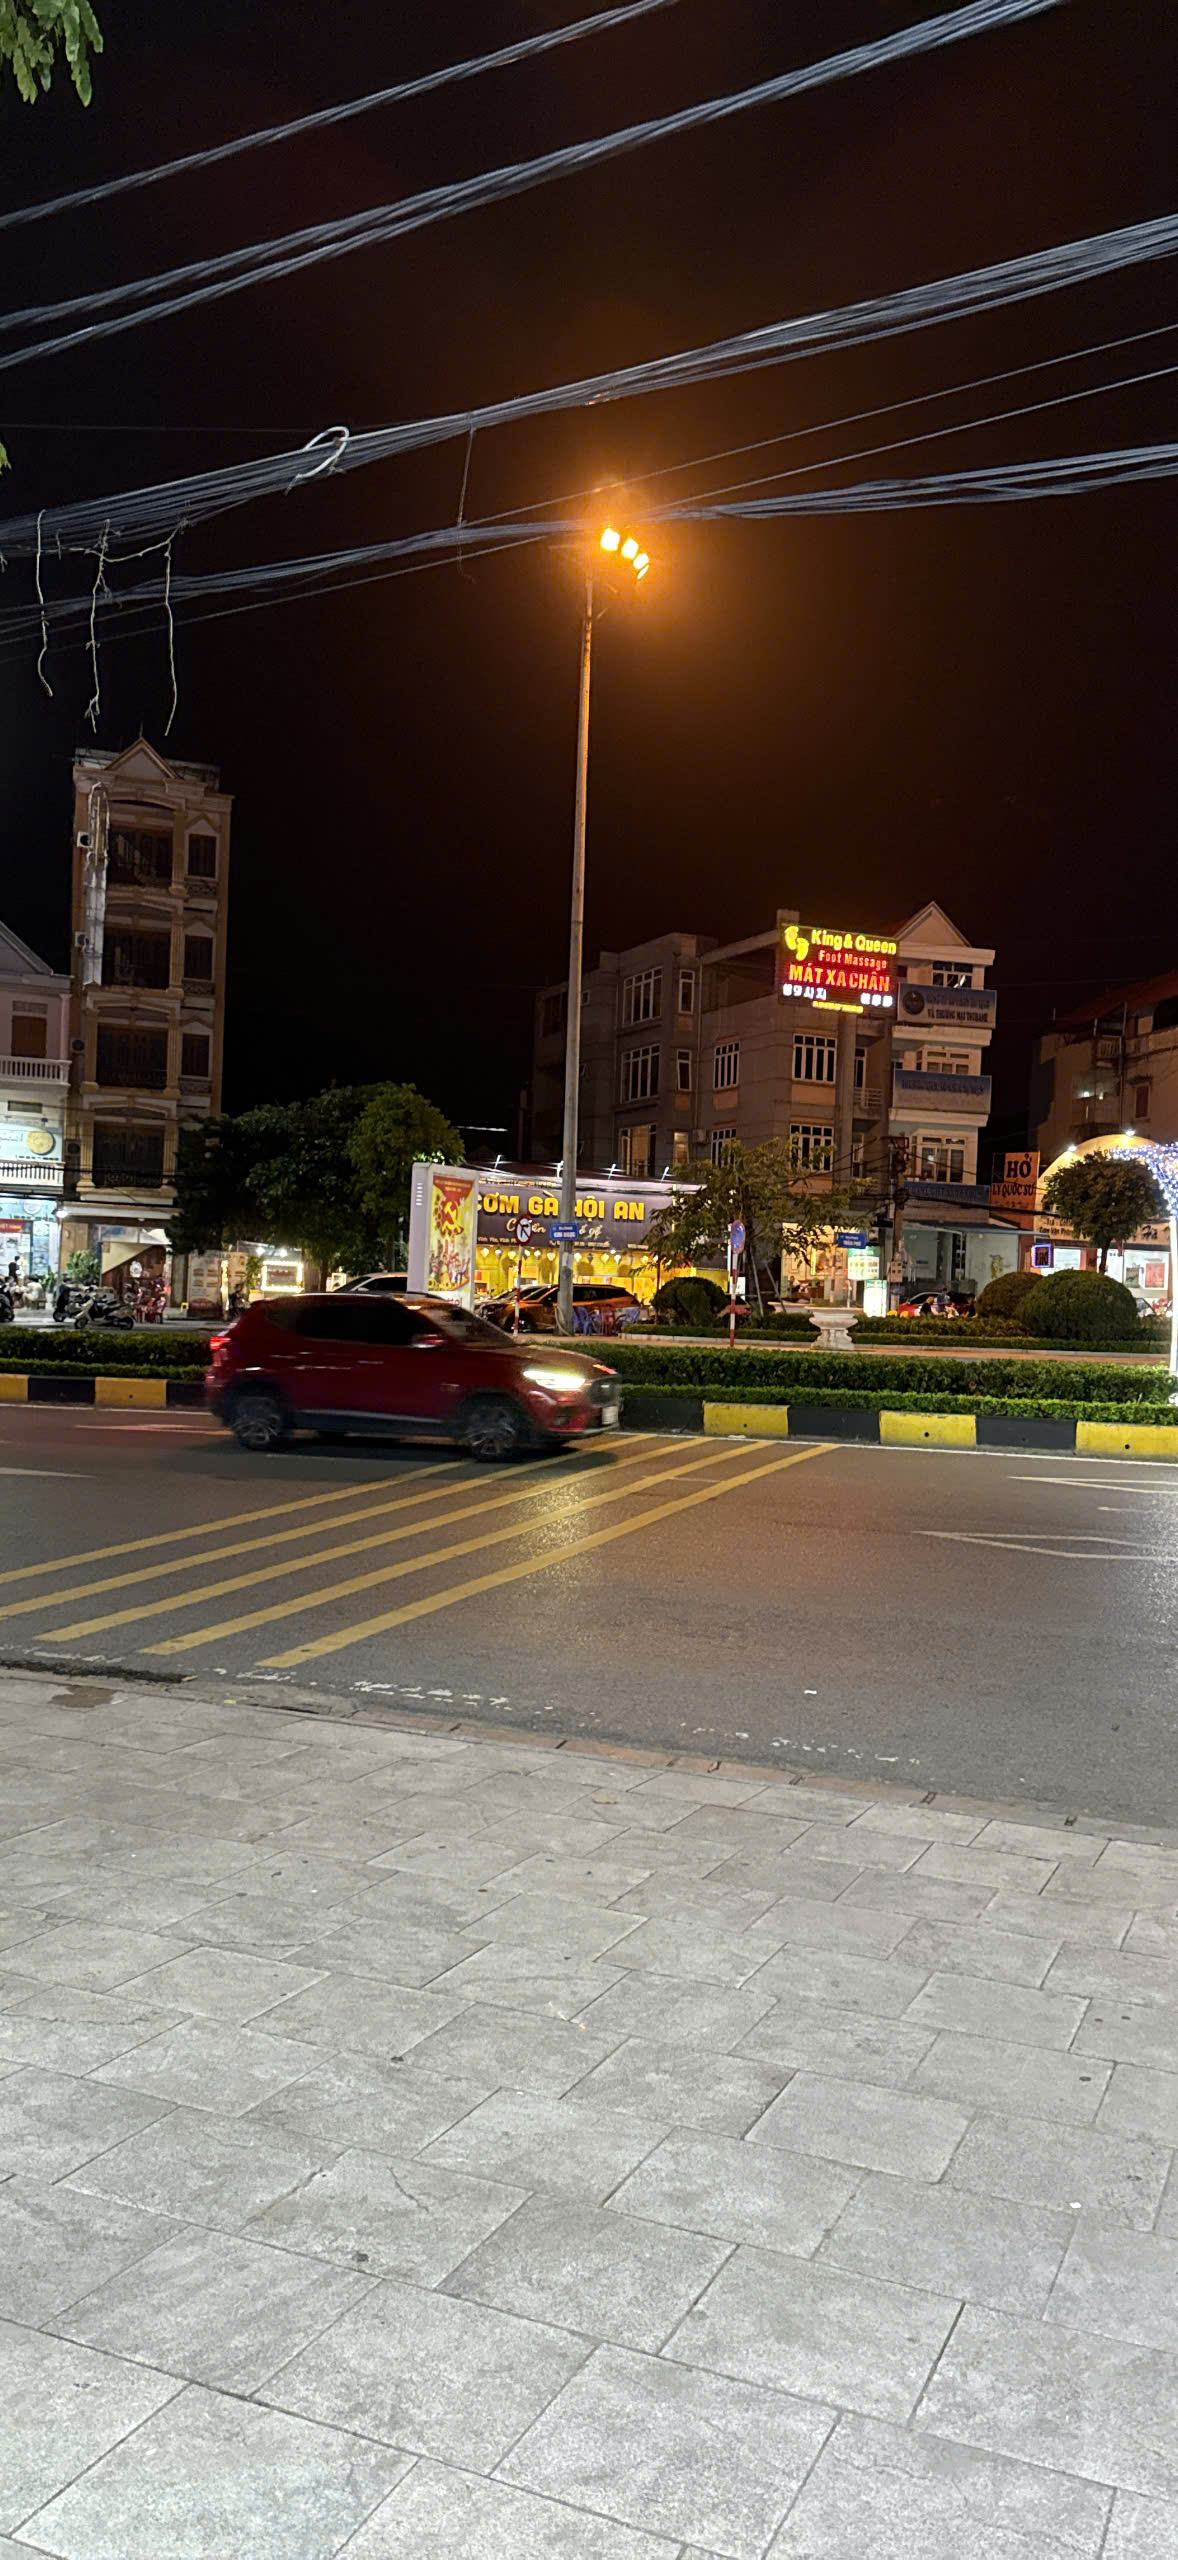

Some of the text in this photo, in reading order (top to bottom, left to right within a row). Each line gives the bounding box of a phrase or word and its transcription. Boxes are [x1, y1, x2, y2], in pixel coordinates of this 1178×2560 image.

[811, 929, 897, 955] King & Queen
[819, 950, 887, 971] Foot Massage
[788, 962, 890, 992] MÁT XA CHÂN
[527, 1190, 559, 1216] GÀ
[613, 1201, 645, 1220] AN
